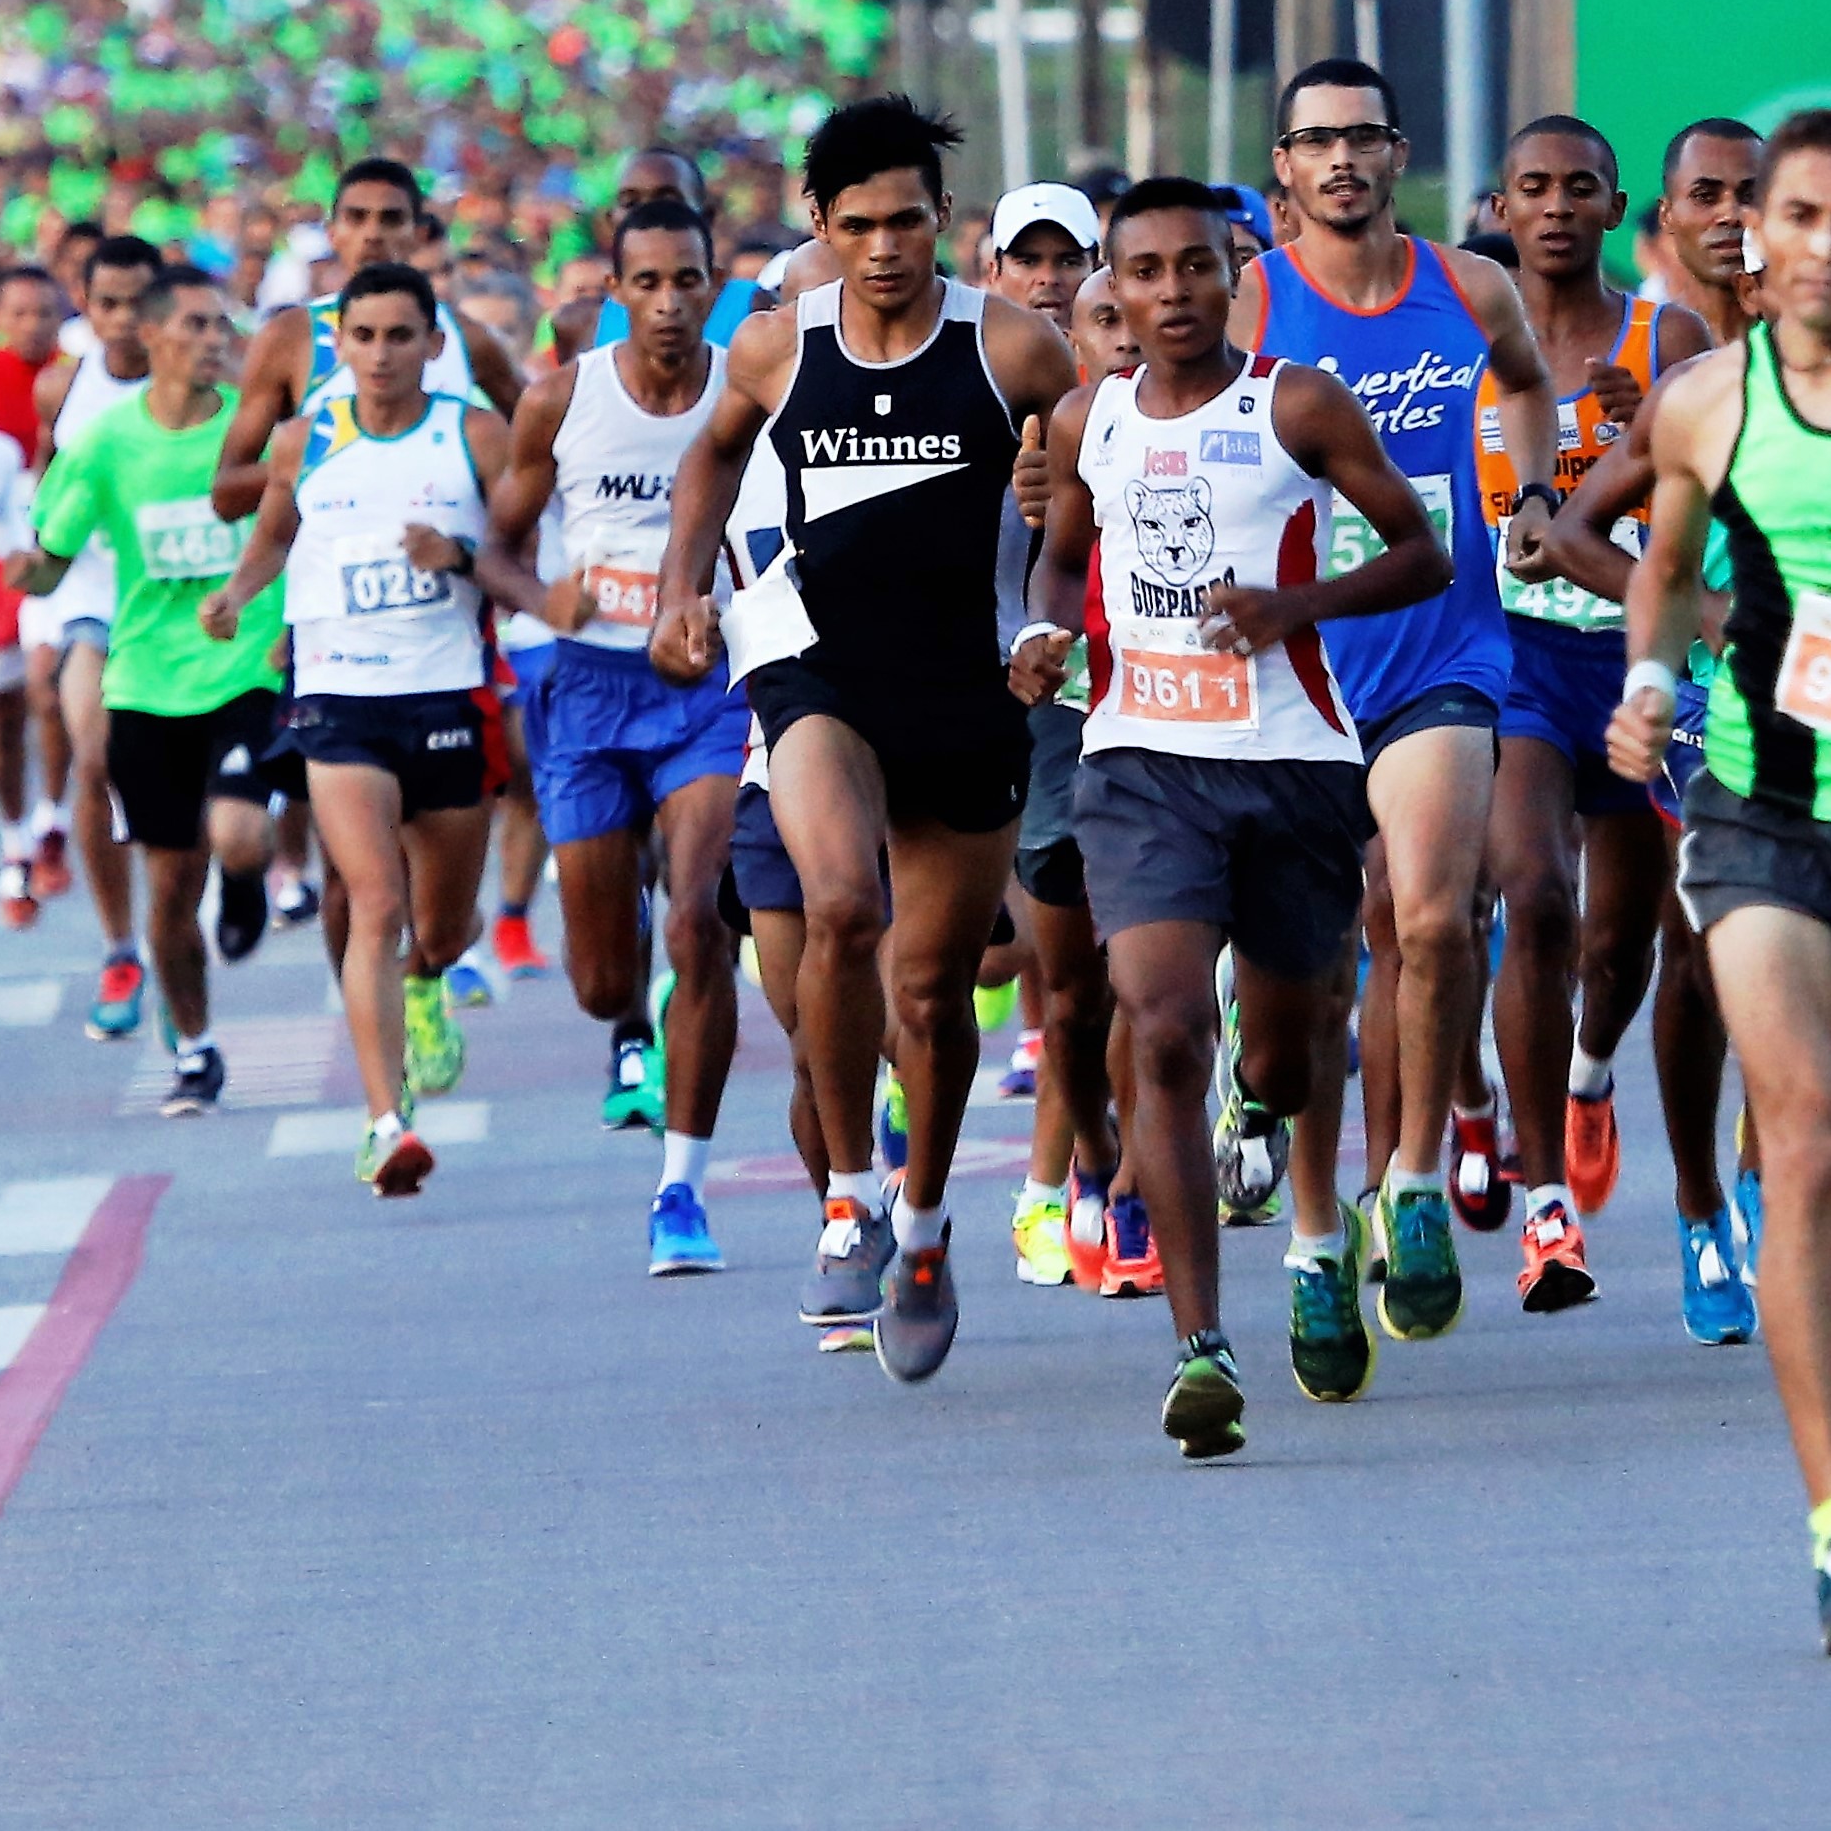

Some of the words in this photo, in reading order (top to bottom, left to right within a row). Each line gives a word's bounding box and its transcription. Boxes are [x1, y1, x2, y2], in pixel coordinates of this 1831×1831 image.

[800, 427, 961, 464] Winnes
[597, 576, 658, 617] 94
[1132, 666, 1202, 709] 961
